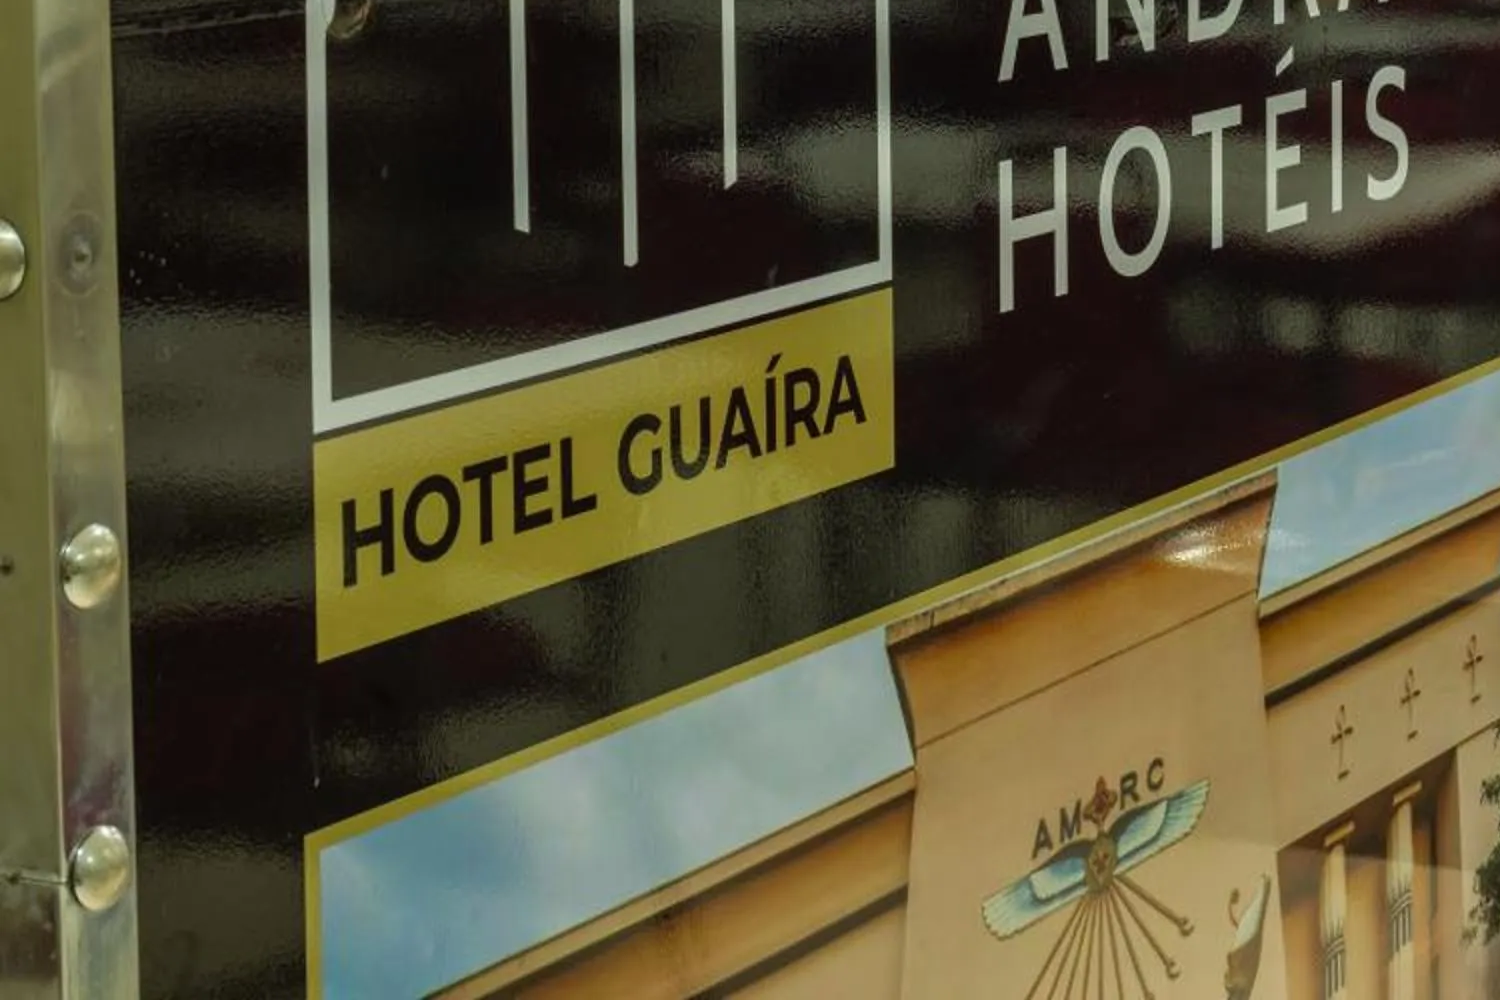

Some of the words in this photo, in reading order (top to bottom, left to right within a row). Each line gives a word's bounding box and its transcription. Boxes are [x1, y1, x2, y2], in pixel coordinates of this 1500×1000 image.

[999, 45, 1410, 313] HOTÉIS
[342, 438, 597, 587] HOTEL
[617, 354, 867, 496] GUAÍRA
